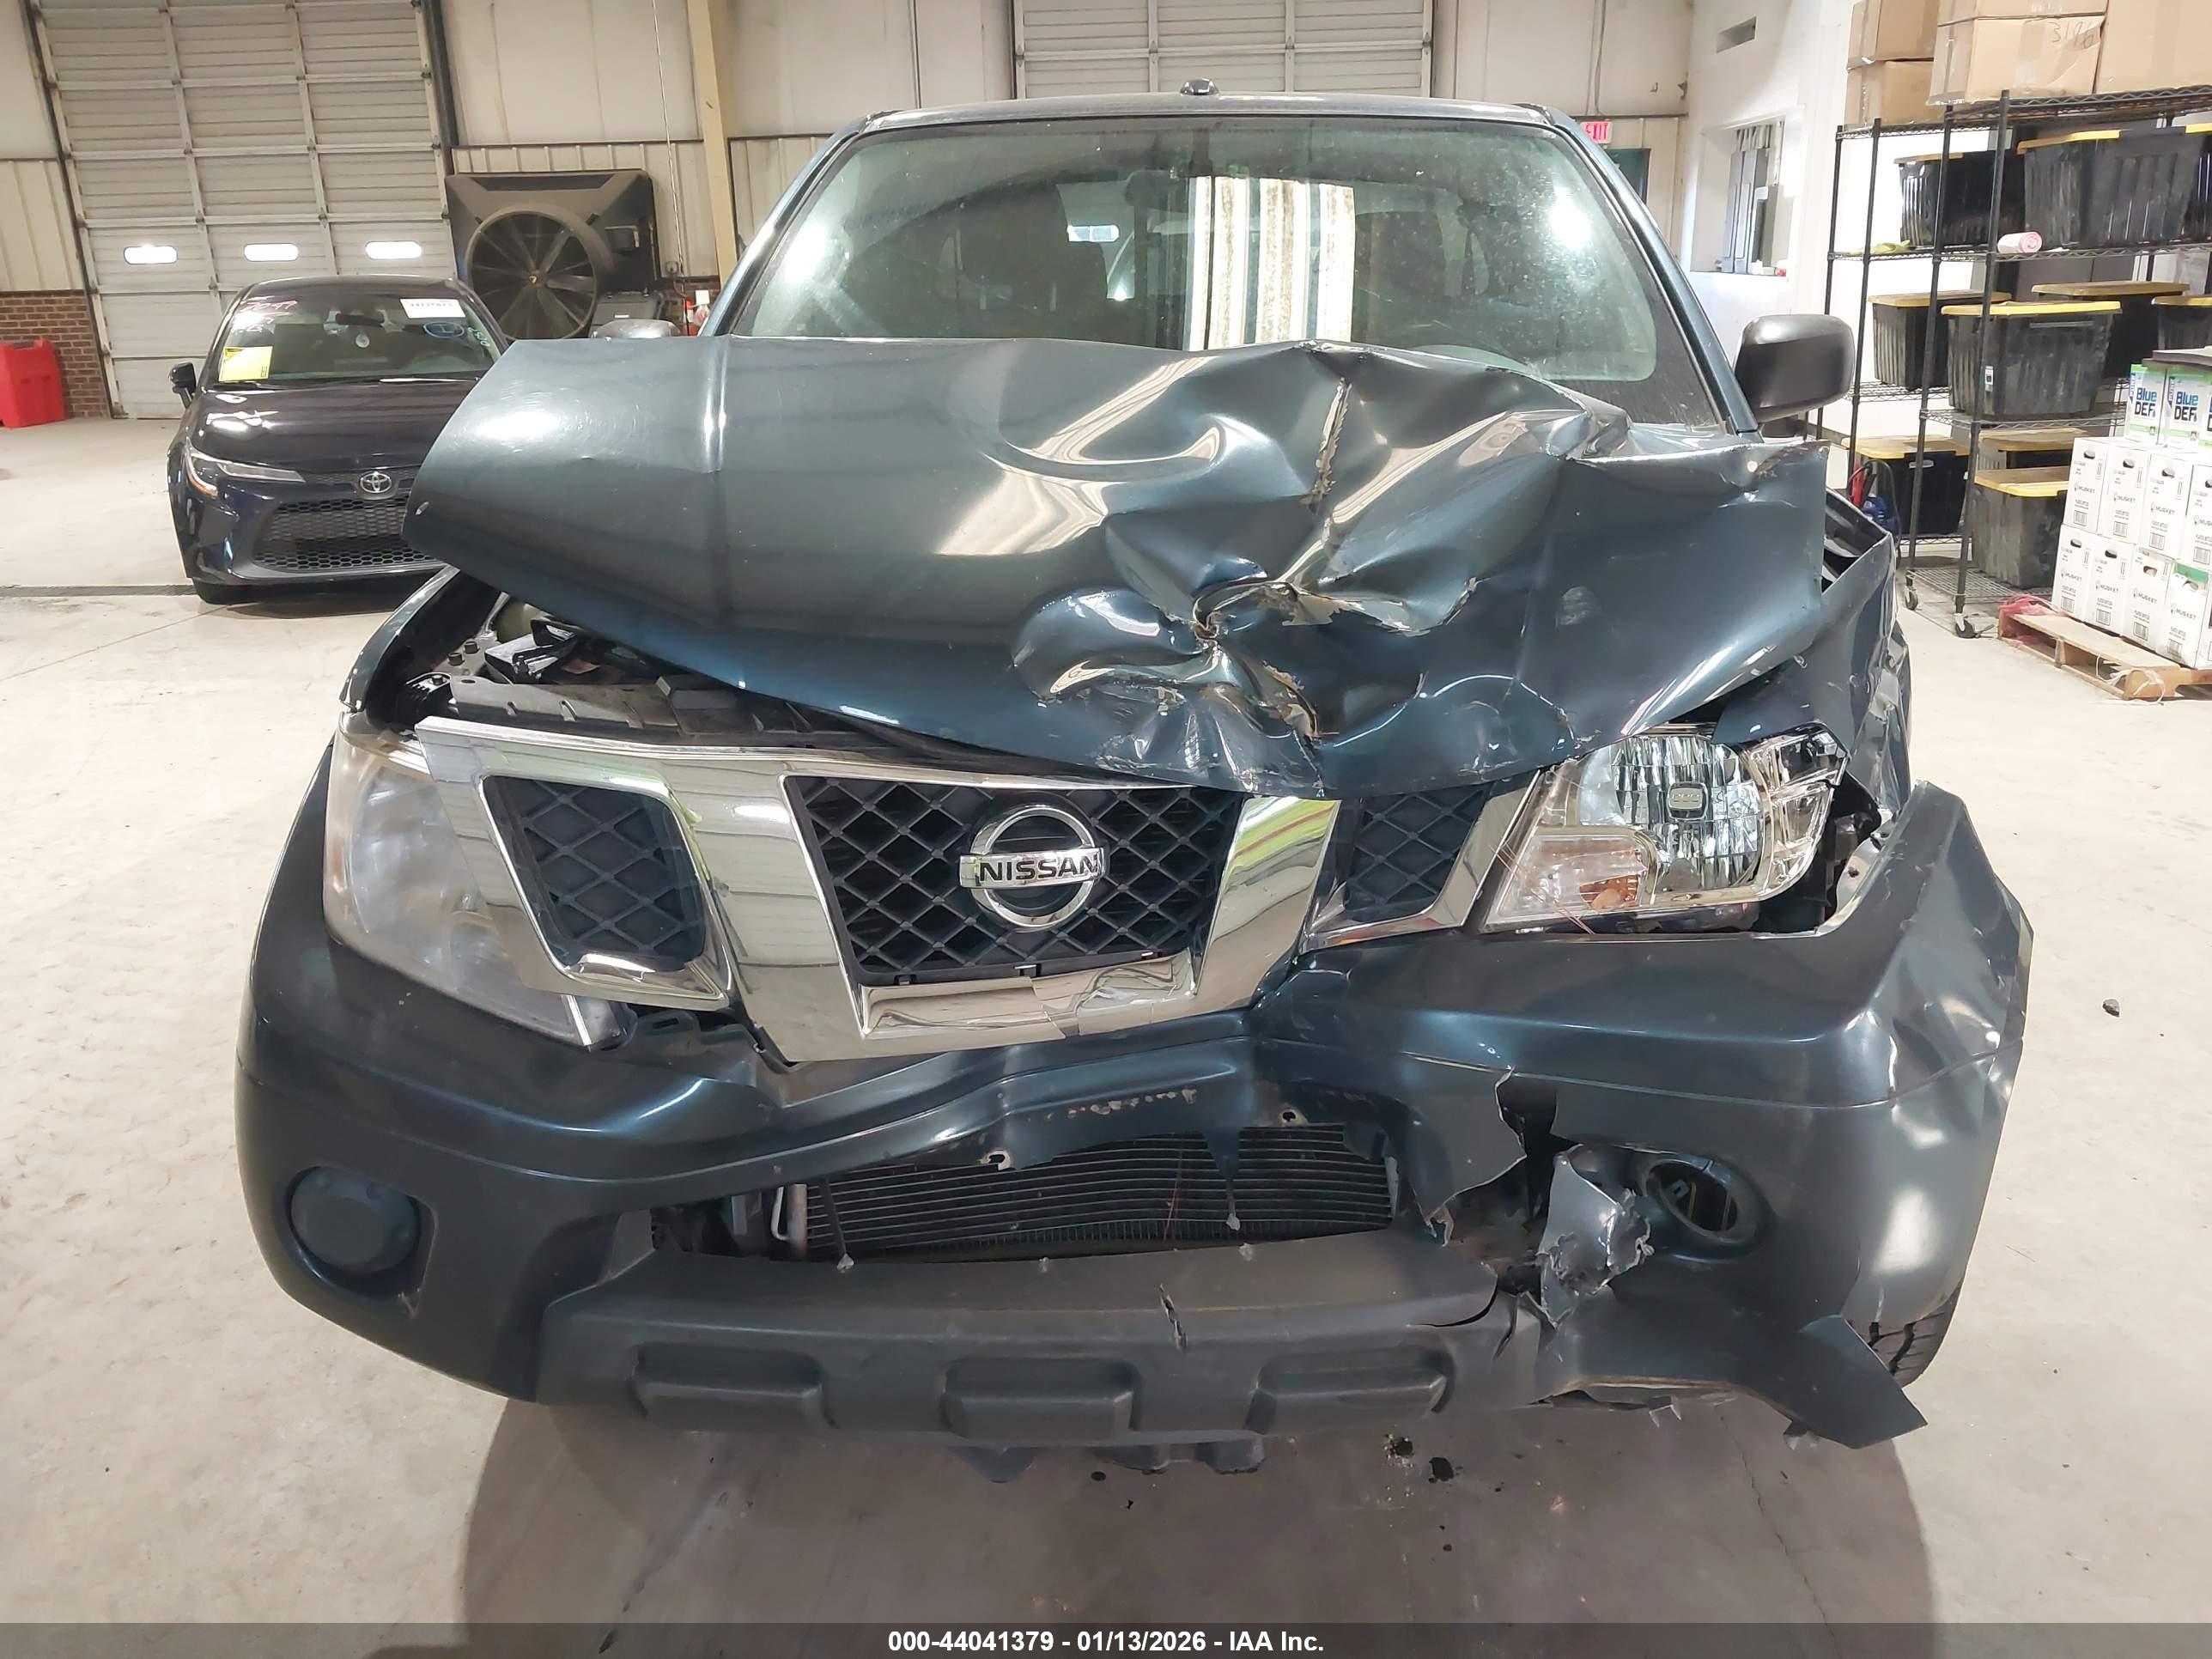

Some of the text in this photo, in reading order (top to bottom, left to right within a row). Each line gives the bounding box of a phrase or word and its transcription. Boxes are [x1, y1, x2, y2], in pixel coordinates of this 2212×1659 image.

[2136, 387, 2157, 403] Blue
[2176, 392, 2198, 406] Blue
[2134, 402, 2155, 417] DEF
[2174, 406, 2197, 422] DEF
[2138, 592, 2158, 605] MUSKET
[2176, 608, 2197, 619] MUSKET
[980, 854, 1098, 882] NISSAN
